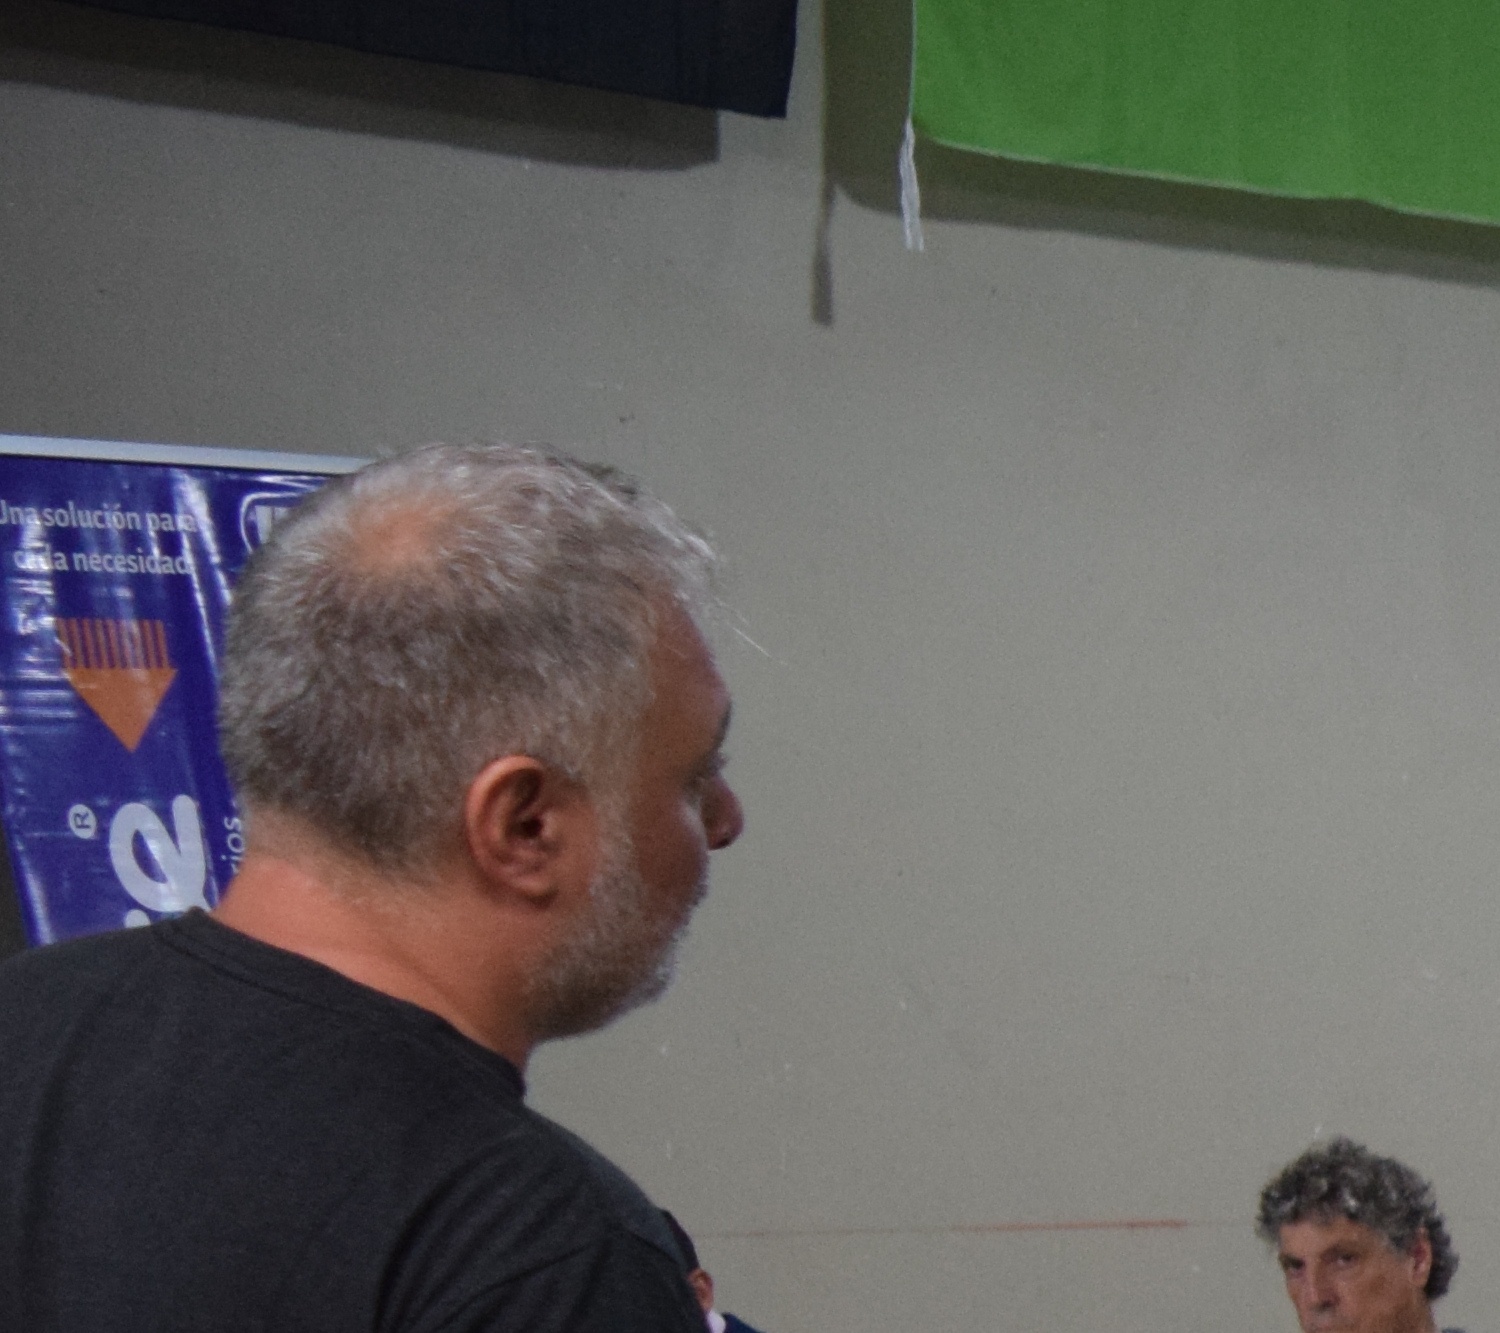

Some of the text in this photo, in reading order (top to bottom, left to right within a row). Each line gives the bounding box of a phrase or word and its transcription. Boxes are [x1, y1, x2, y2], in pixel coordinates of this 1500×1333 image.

[44, 500, 142, 530] solución
[147, 512, 199, 534] para
[73, 547, 195, 576] necesidad
